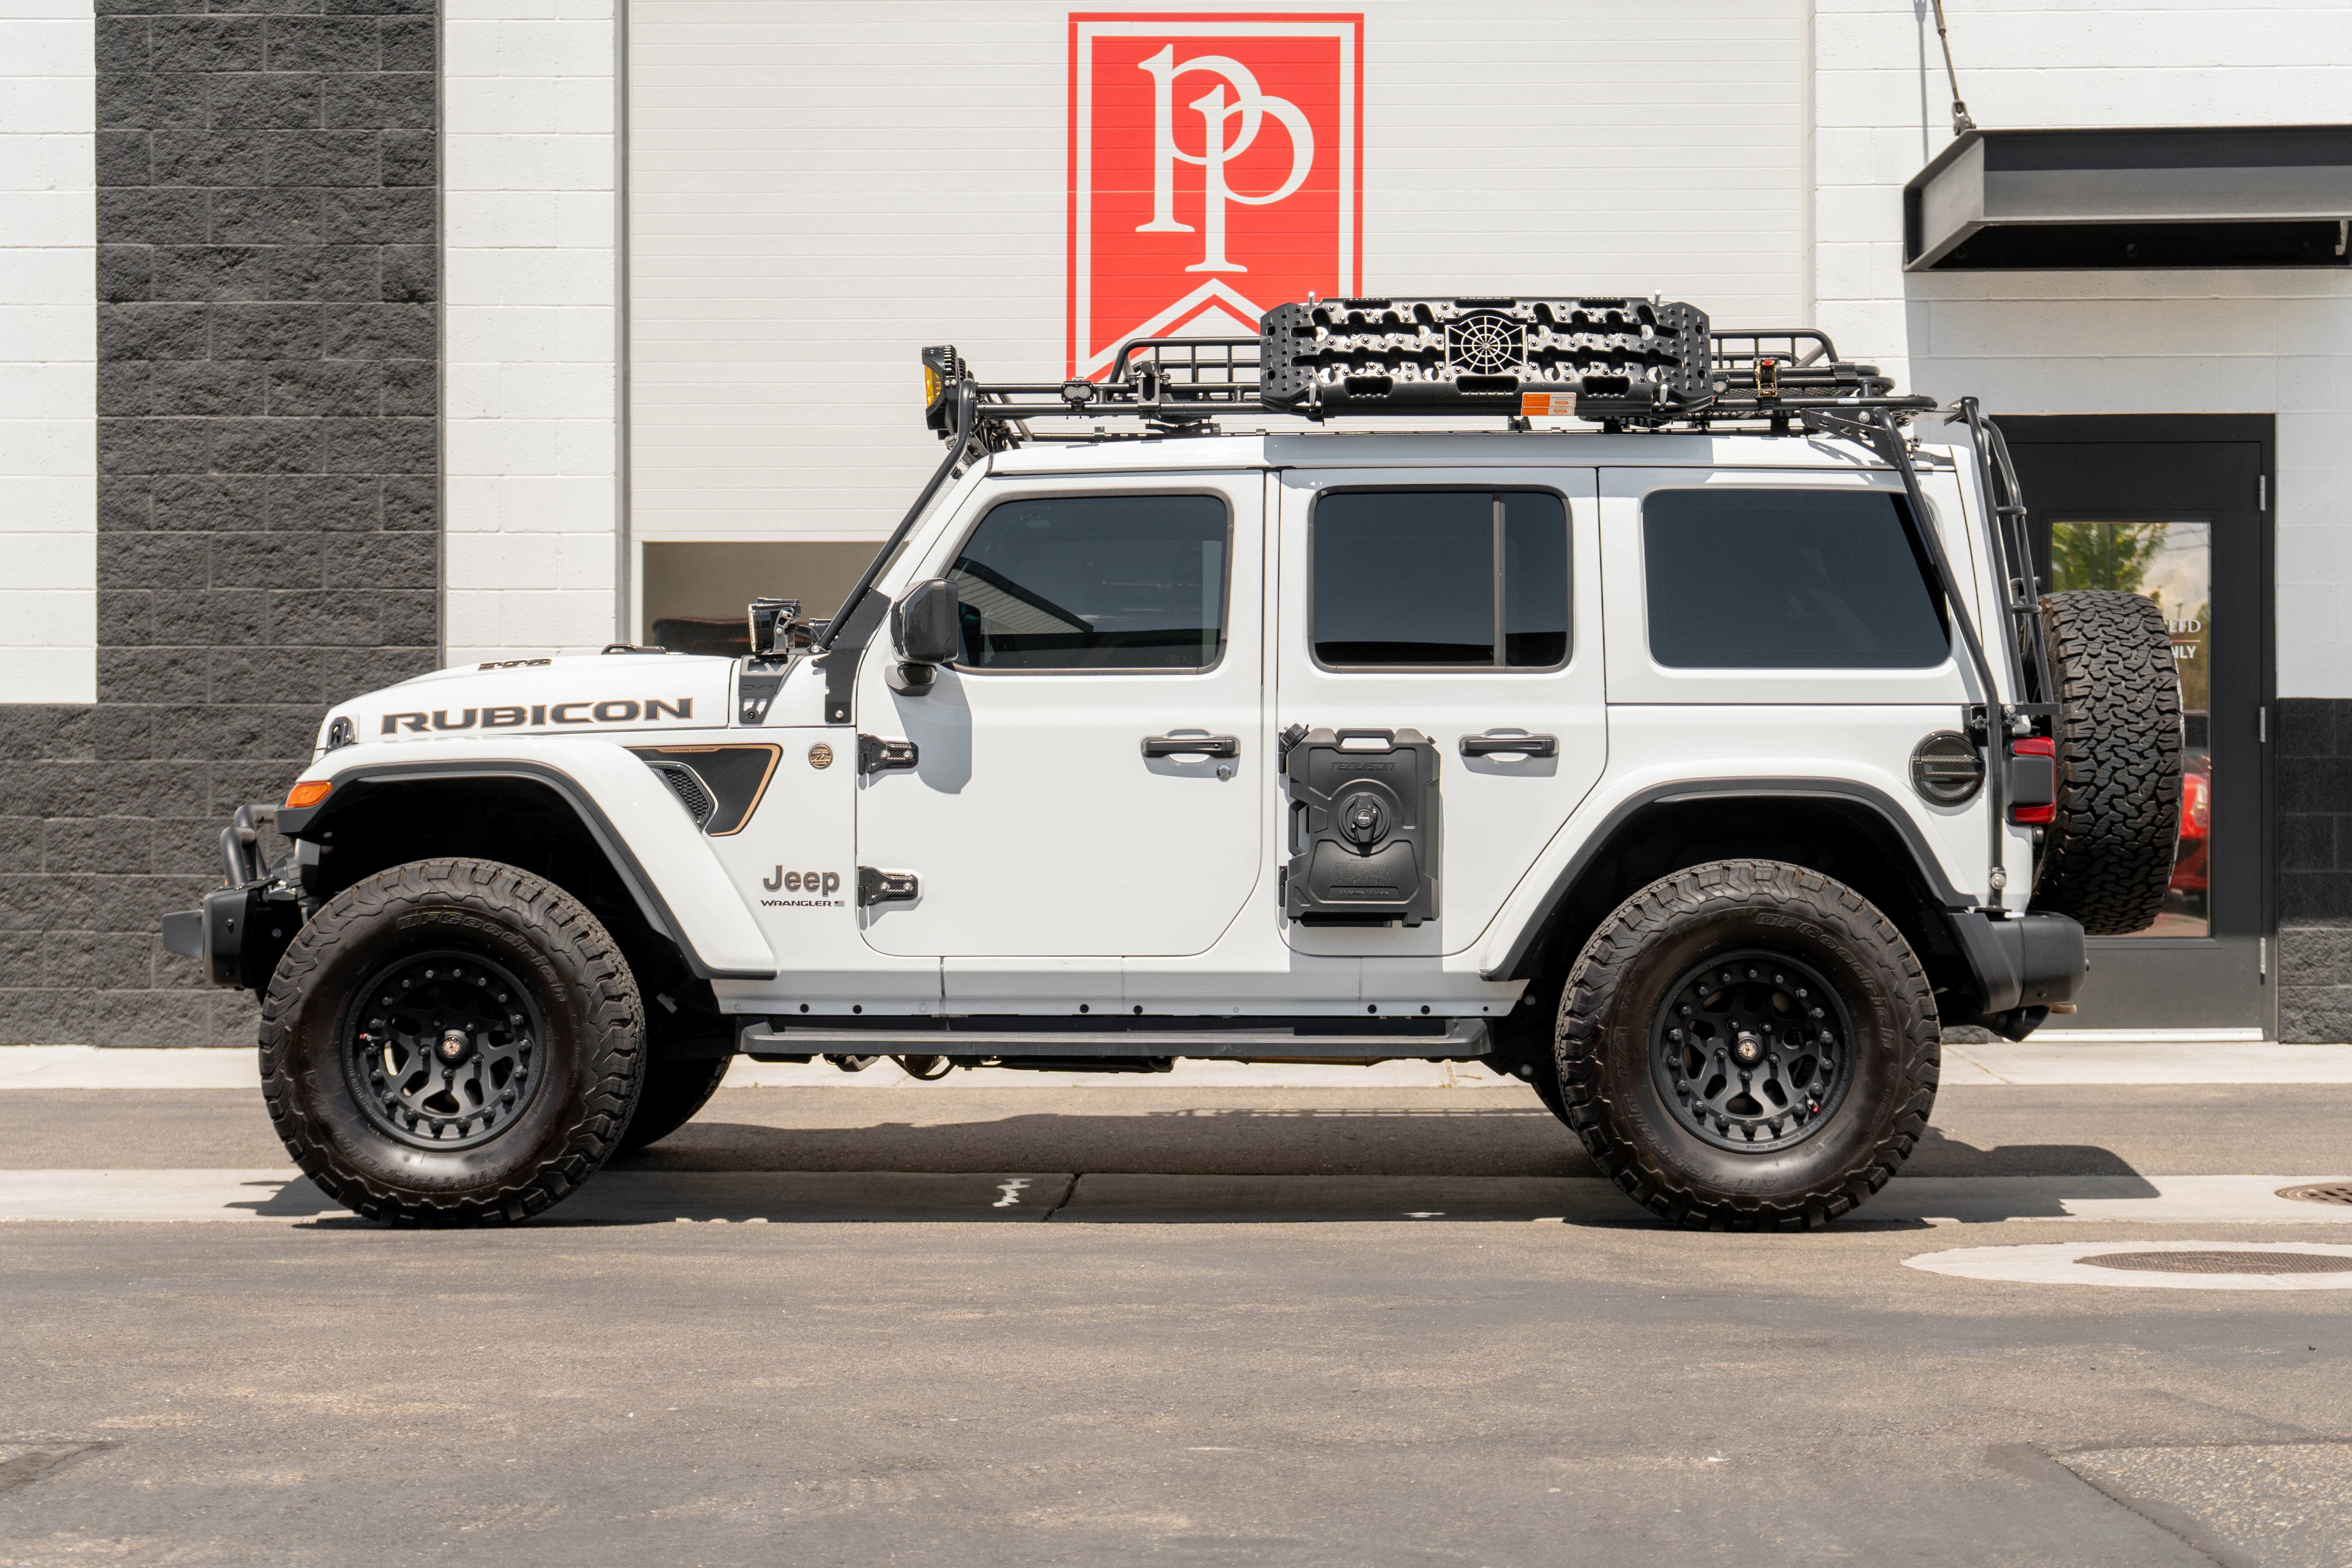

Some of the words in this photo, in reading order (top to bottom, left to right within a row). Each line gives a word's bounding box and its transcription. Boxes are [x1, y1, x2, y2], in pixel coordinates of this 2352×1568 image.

[2169, 619, 2201, 633] LTD
[2171, 645, 2196, 659] NLY
[381, 697, 693, 735] RUBICON
[763, 864, 840, 897] Jeep
[396, 909, 568, 1004] BFGoodrich
[1755, 912, 1897, 1050] BFGoodrich
